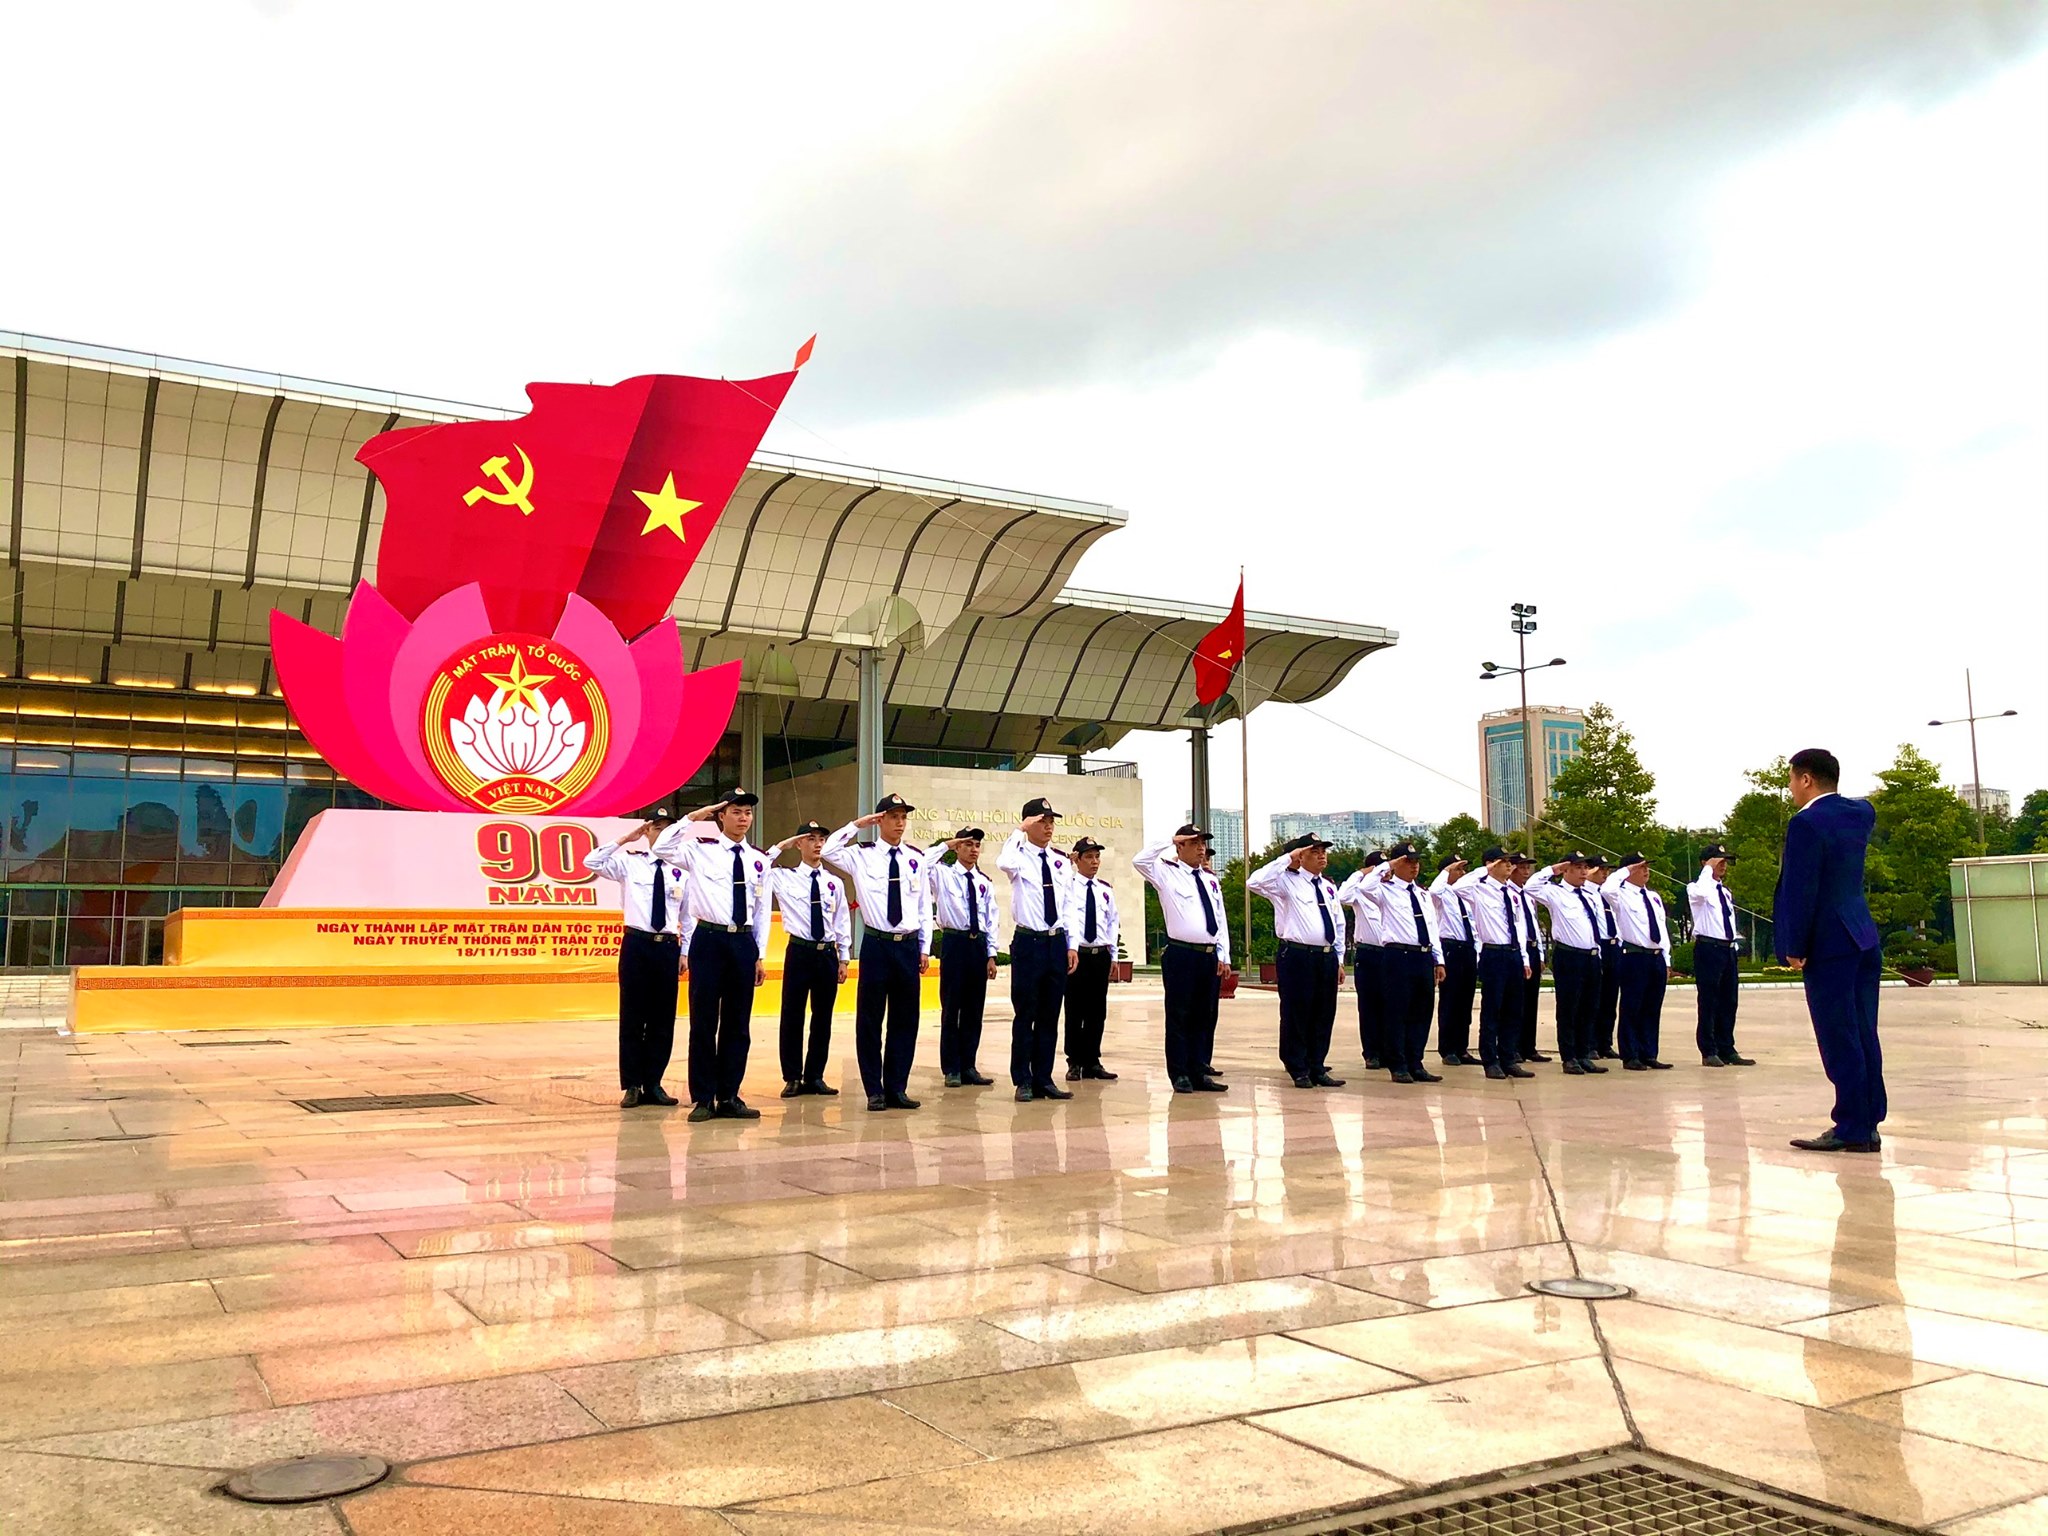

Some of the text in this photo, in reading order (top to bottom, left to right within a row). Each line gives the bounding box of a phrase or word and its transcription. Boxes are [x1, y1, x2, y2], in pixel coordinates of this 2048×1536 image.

[452, 643, 581, 682] MẶT TRẬN TỔ QUỐC
[488, 783, 556, 801] VIỆT NAM
[1099, 815, 1124, 829] GIA
[475, 820, 596, 884] 90
[487, 883, 597, 905] NĂM
[317, 922, 359, 933] NGÀY
[364, 922, 415, 933] THÀNH
[420, 922, 448, 935] LẬP
[490, 922, 528, 935] TRẬN
[532, 922, 562, 933] DÂN
[566, 922, 592, 935] TỘC
[353, 934, 395, 945] NGÀY
[463, 933, 511, 945] THỐNG
[551, 934, 588, 947] TRẬN
[456, 947, 537, 957] 18/11/1930
[551, 947, 619, 957] 18/11/202
